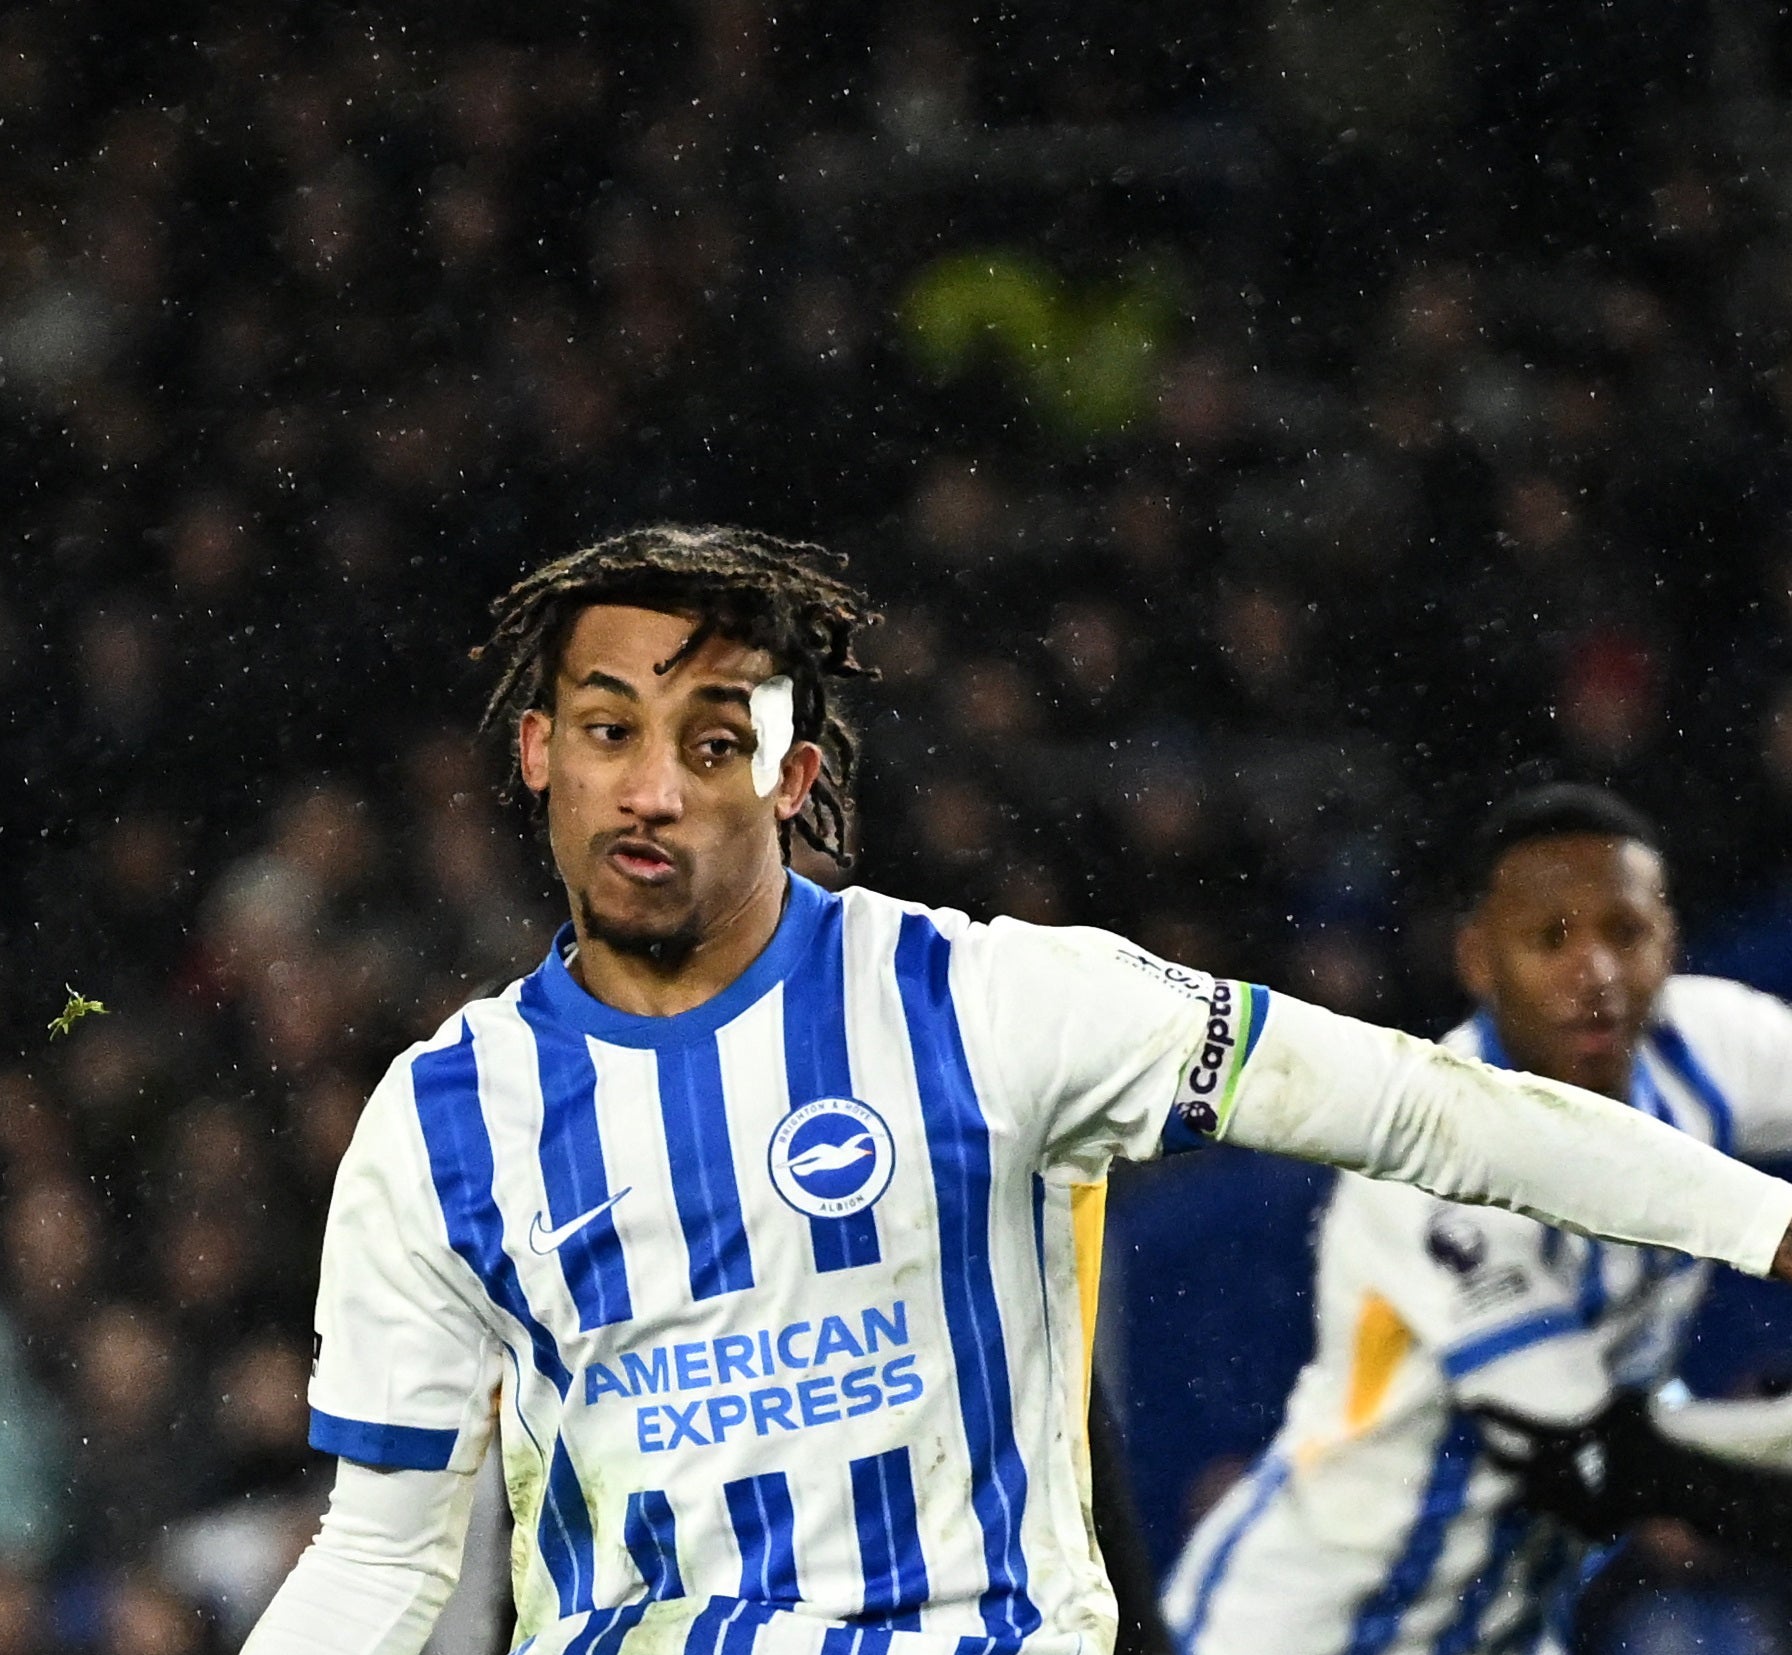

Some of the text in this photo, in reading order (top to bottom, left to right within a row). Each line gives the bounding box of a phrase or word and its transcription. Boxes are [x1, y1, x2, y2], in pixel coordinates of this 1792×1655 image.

[1189, 981, 1234, 1094] Capta
[778, 1103, 826, 1143] BRIGHTON
[845, 1103, 872, 1121] HOVE
[819, 1194, 865, 1213] ALBION
[585, 1300, 909, 1406] AMERICAN
[637, 1354, 924, 1453] EXPRESS
